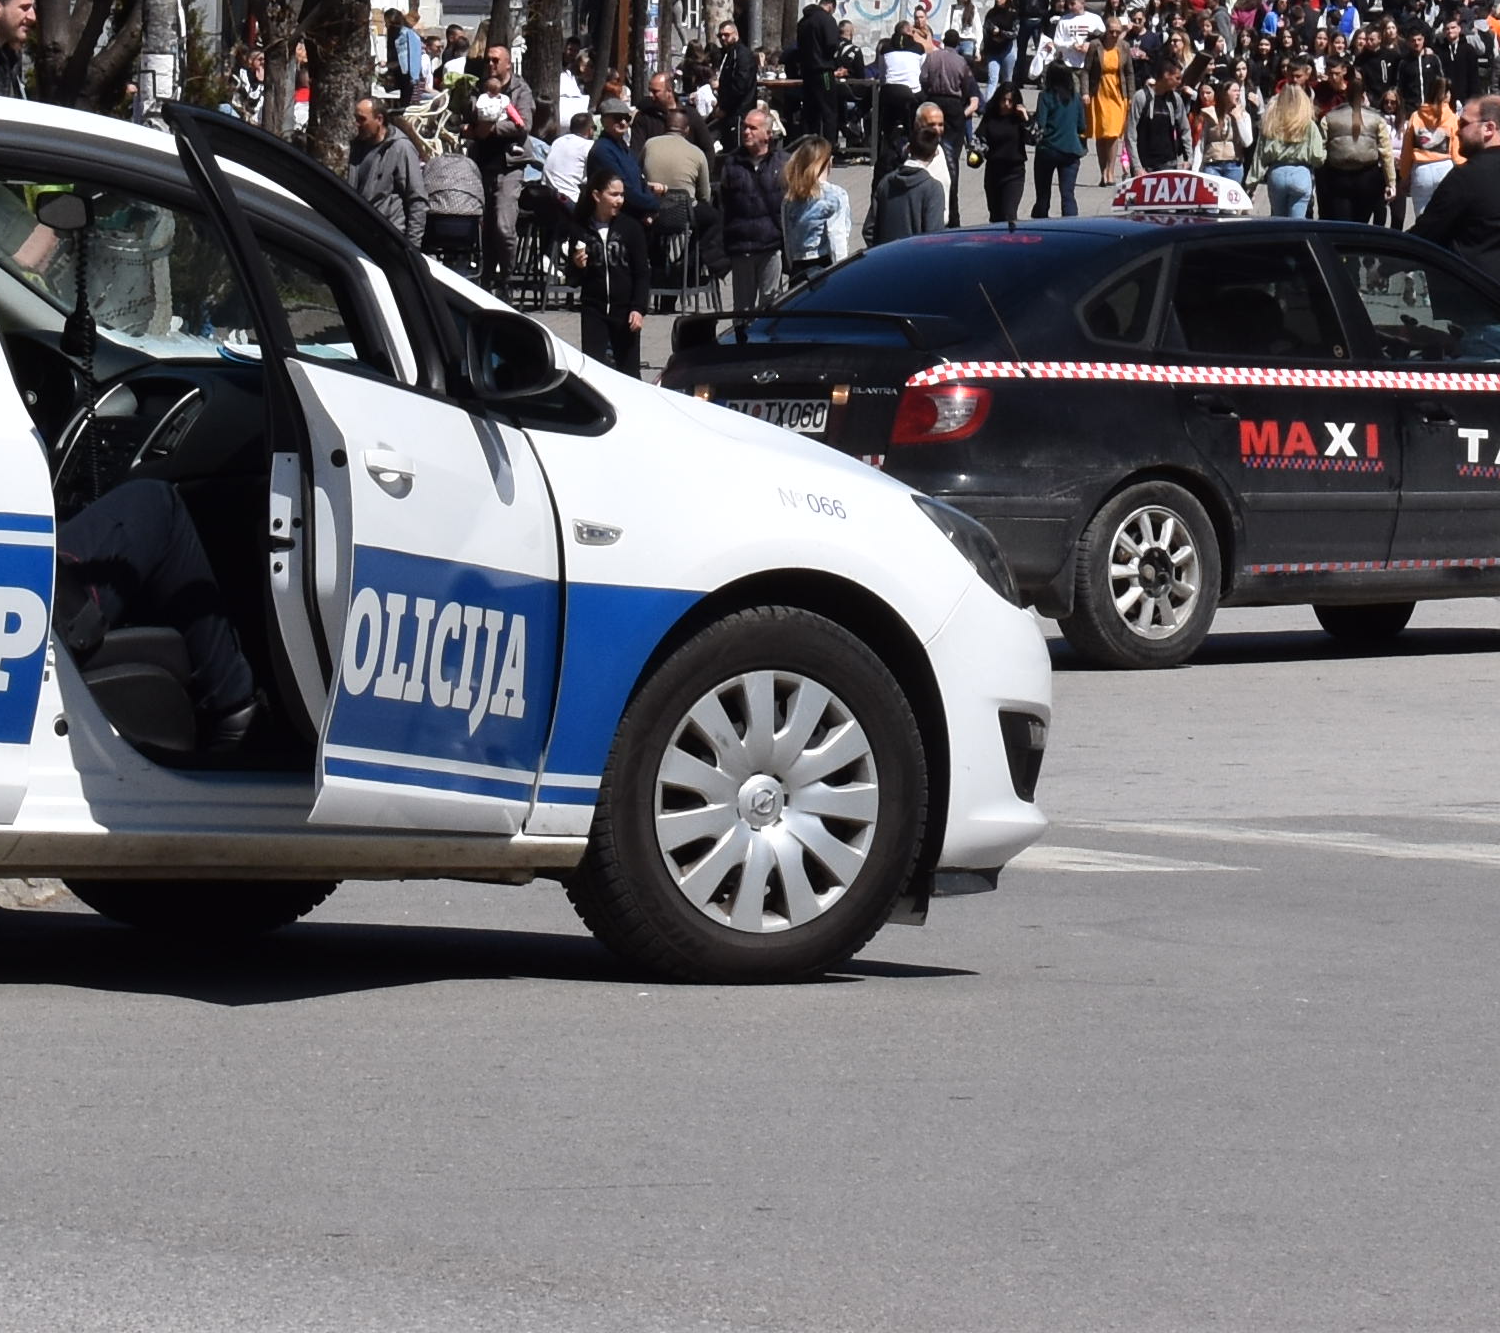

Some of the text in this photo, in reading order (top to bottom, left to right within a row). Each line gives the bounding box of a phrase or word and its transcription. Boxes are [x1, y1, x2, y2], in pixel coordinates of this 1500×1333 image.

[1141, 177, 1198, 203] TAXI
[852, 386, 898, 396] ELANTRA
[1239, 420, 1379, 459] MAXI
[806, 493, 847, 520] 066
[342, 586, 527, 737] OLICIJA
